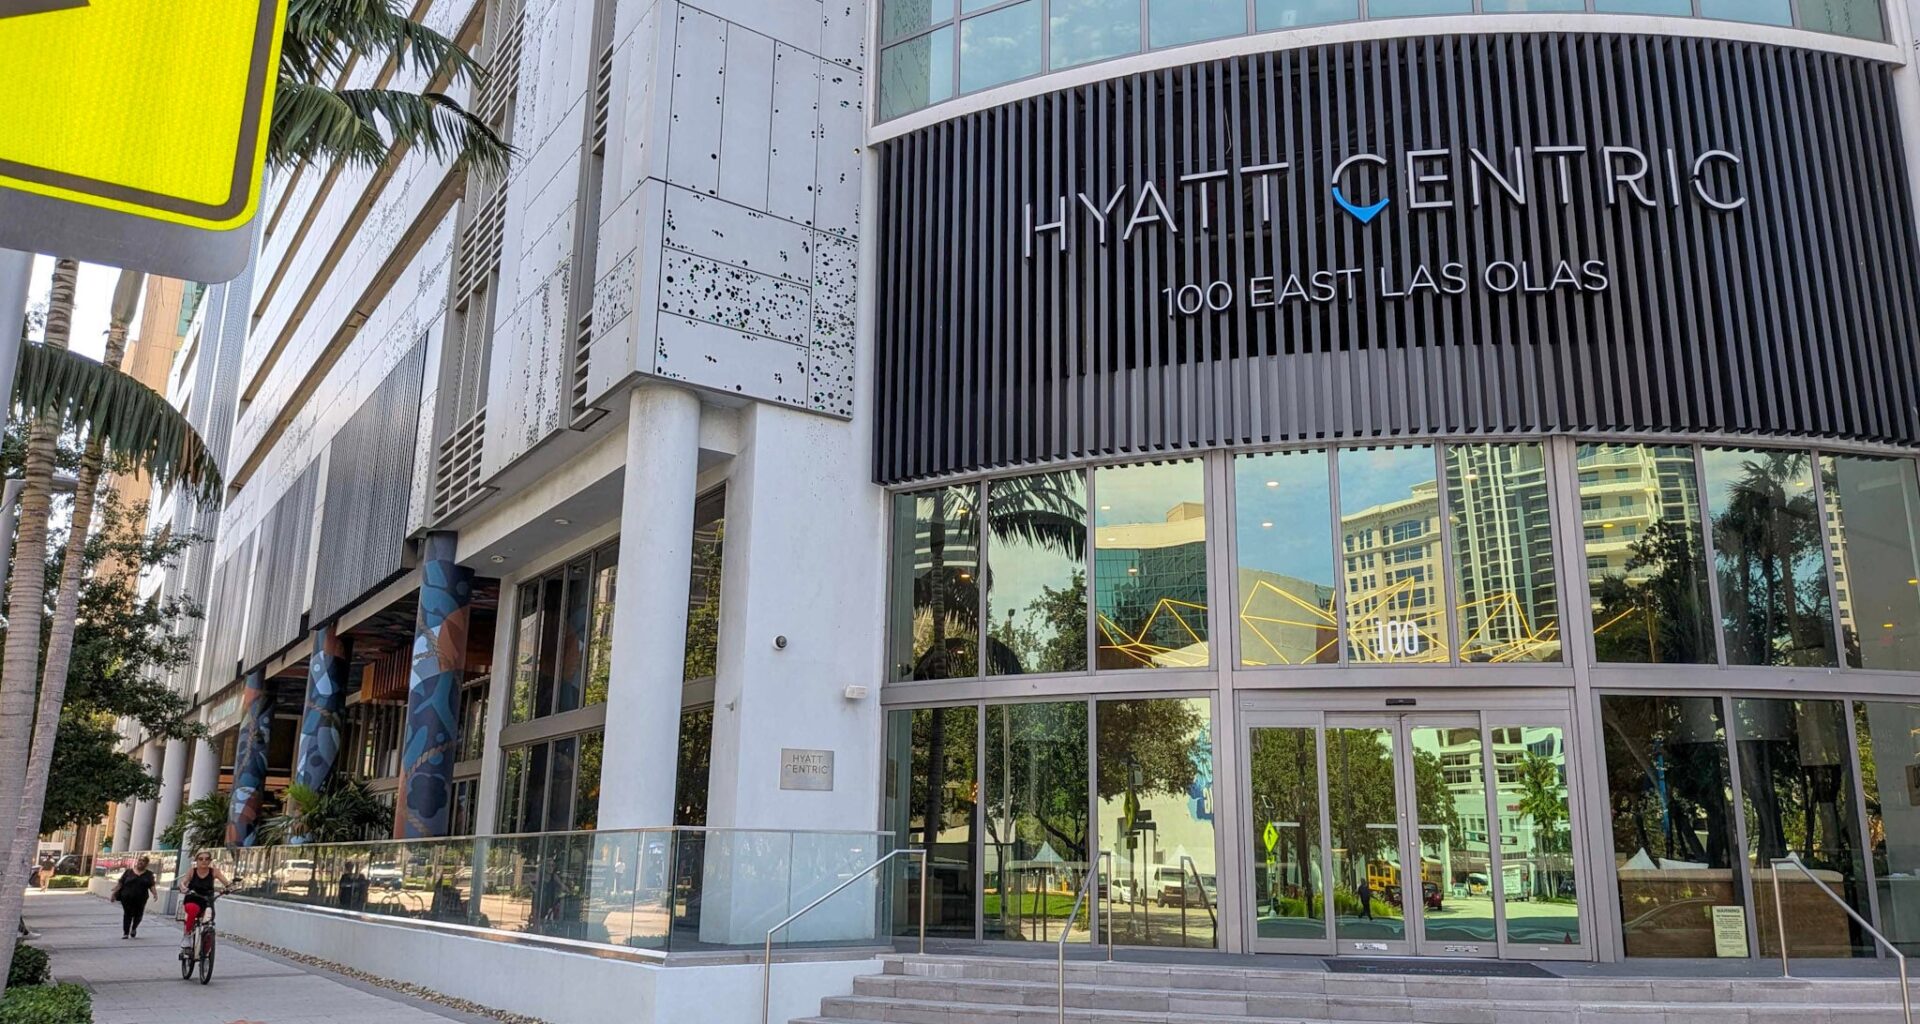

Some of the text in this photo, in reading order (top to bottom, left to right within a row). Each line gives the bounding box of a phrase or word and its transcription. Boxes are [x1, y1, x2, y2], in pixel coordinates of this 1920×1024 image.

[1024, 145, 1747, 260] HYATT CENTRIC
[1162, 258, 1610, 318] 100 EAST LAS OLAS
[1375, 620, 1419, 655] 100
[785, 764, 828, 775] CENTRIC
[792, 754, 824, 764] HYATT
